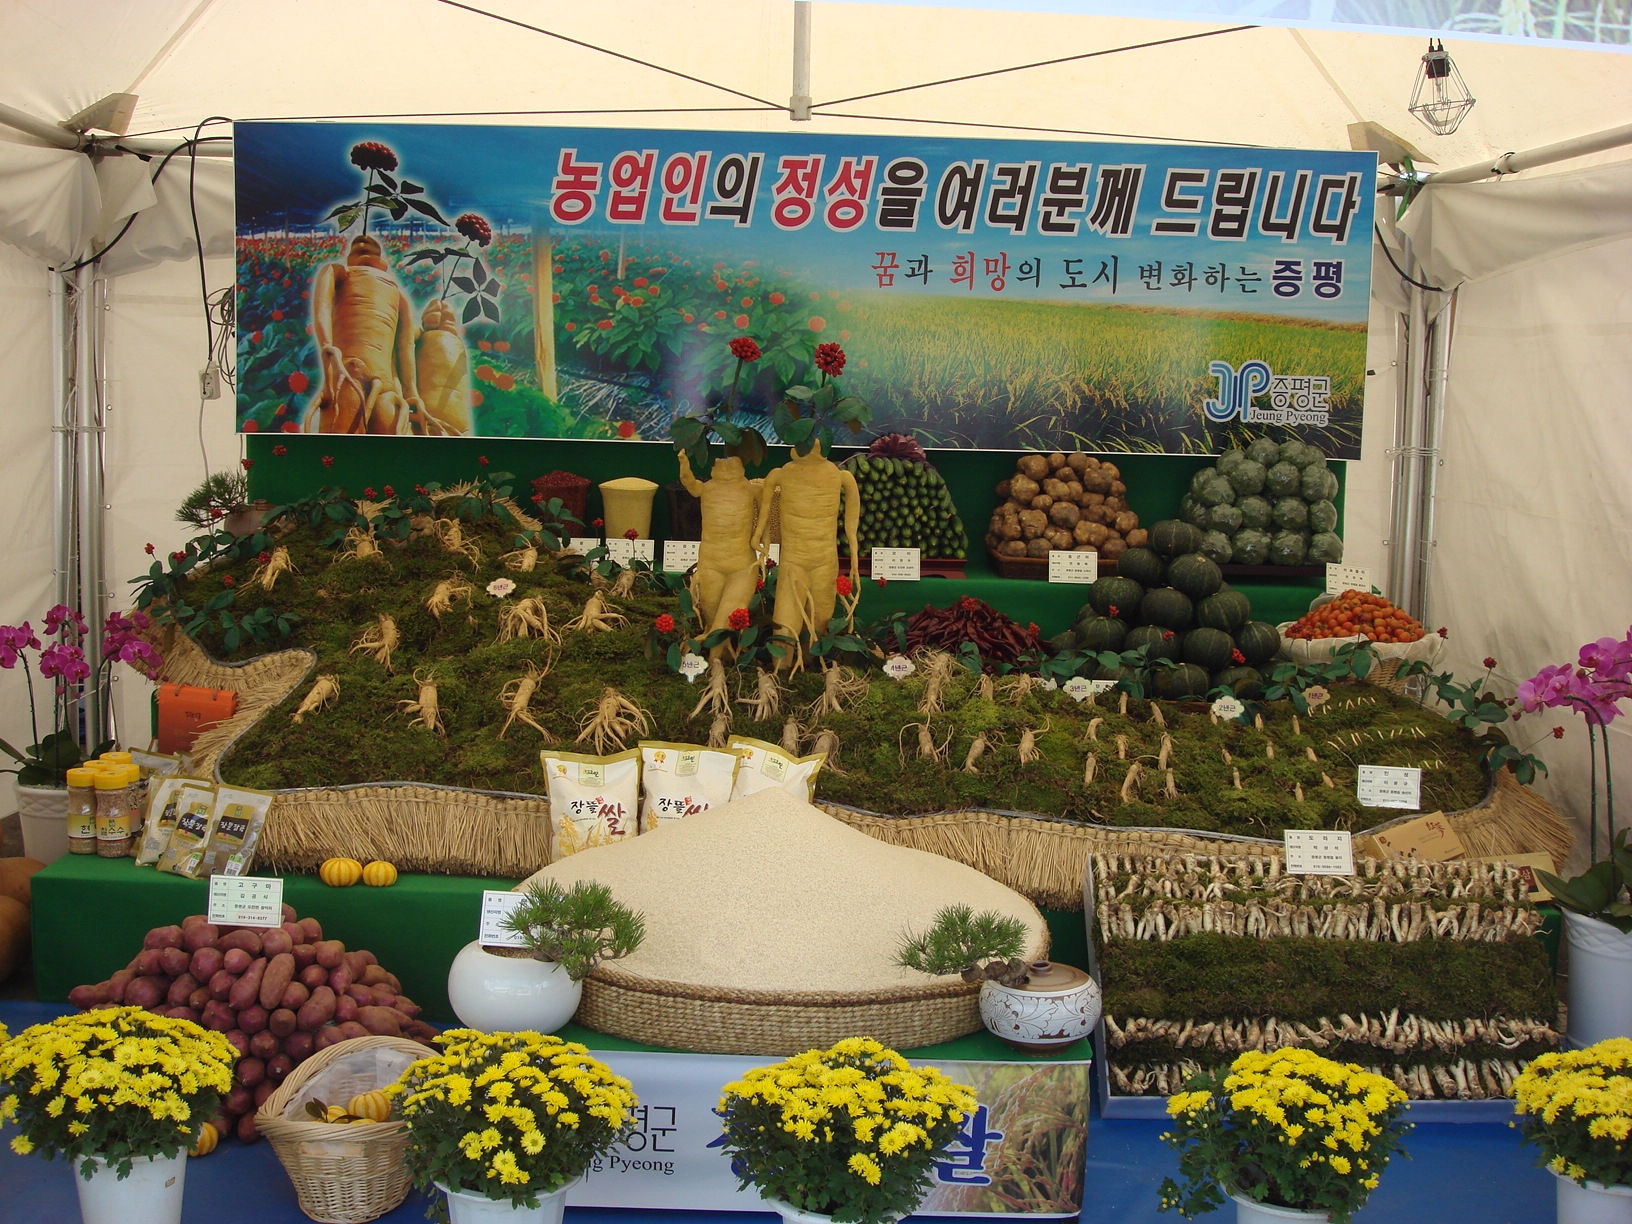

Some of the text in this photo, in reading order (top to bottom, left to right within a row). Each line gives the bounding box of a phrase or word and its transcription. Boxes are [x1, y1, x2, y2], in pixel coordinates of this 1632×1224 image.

[550, 149, 1361, 245] 농업인의 정성을 여러분께 드립니다
[871, 251, 1344, 299] 꿈과 희망의 도시 변화하는 증평
[1273, 377, 1329, 409] 증평군
[1250, 409, 1327, 424] Jeung Pyeong
[1069, 684, 1087, 693] 3년근
[1218, 704, 1236, 712] 2년근
[238, 882, 272, 890] 고구마
[609, 1155, 675, 1176] Pyeong
